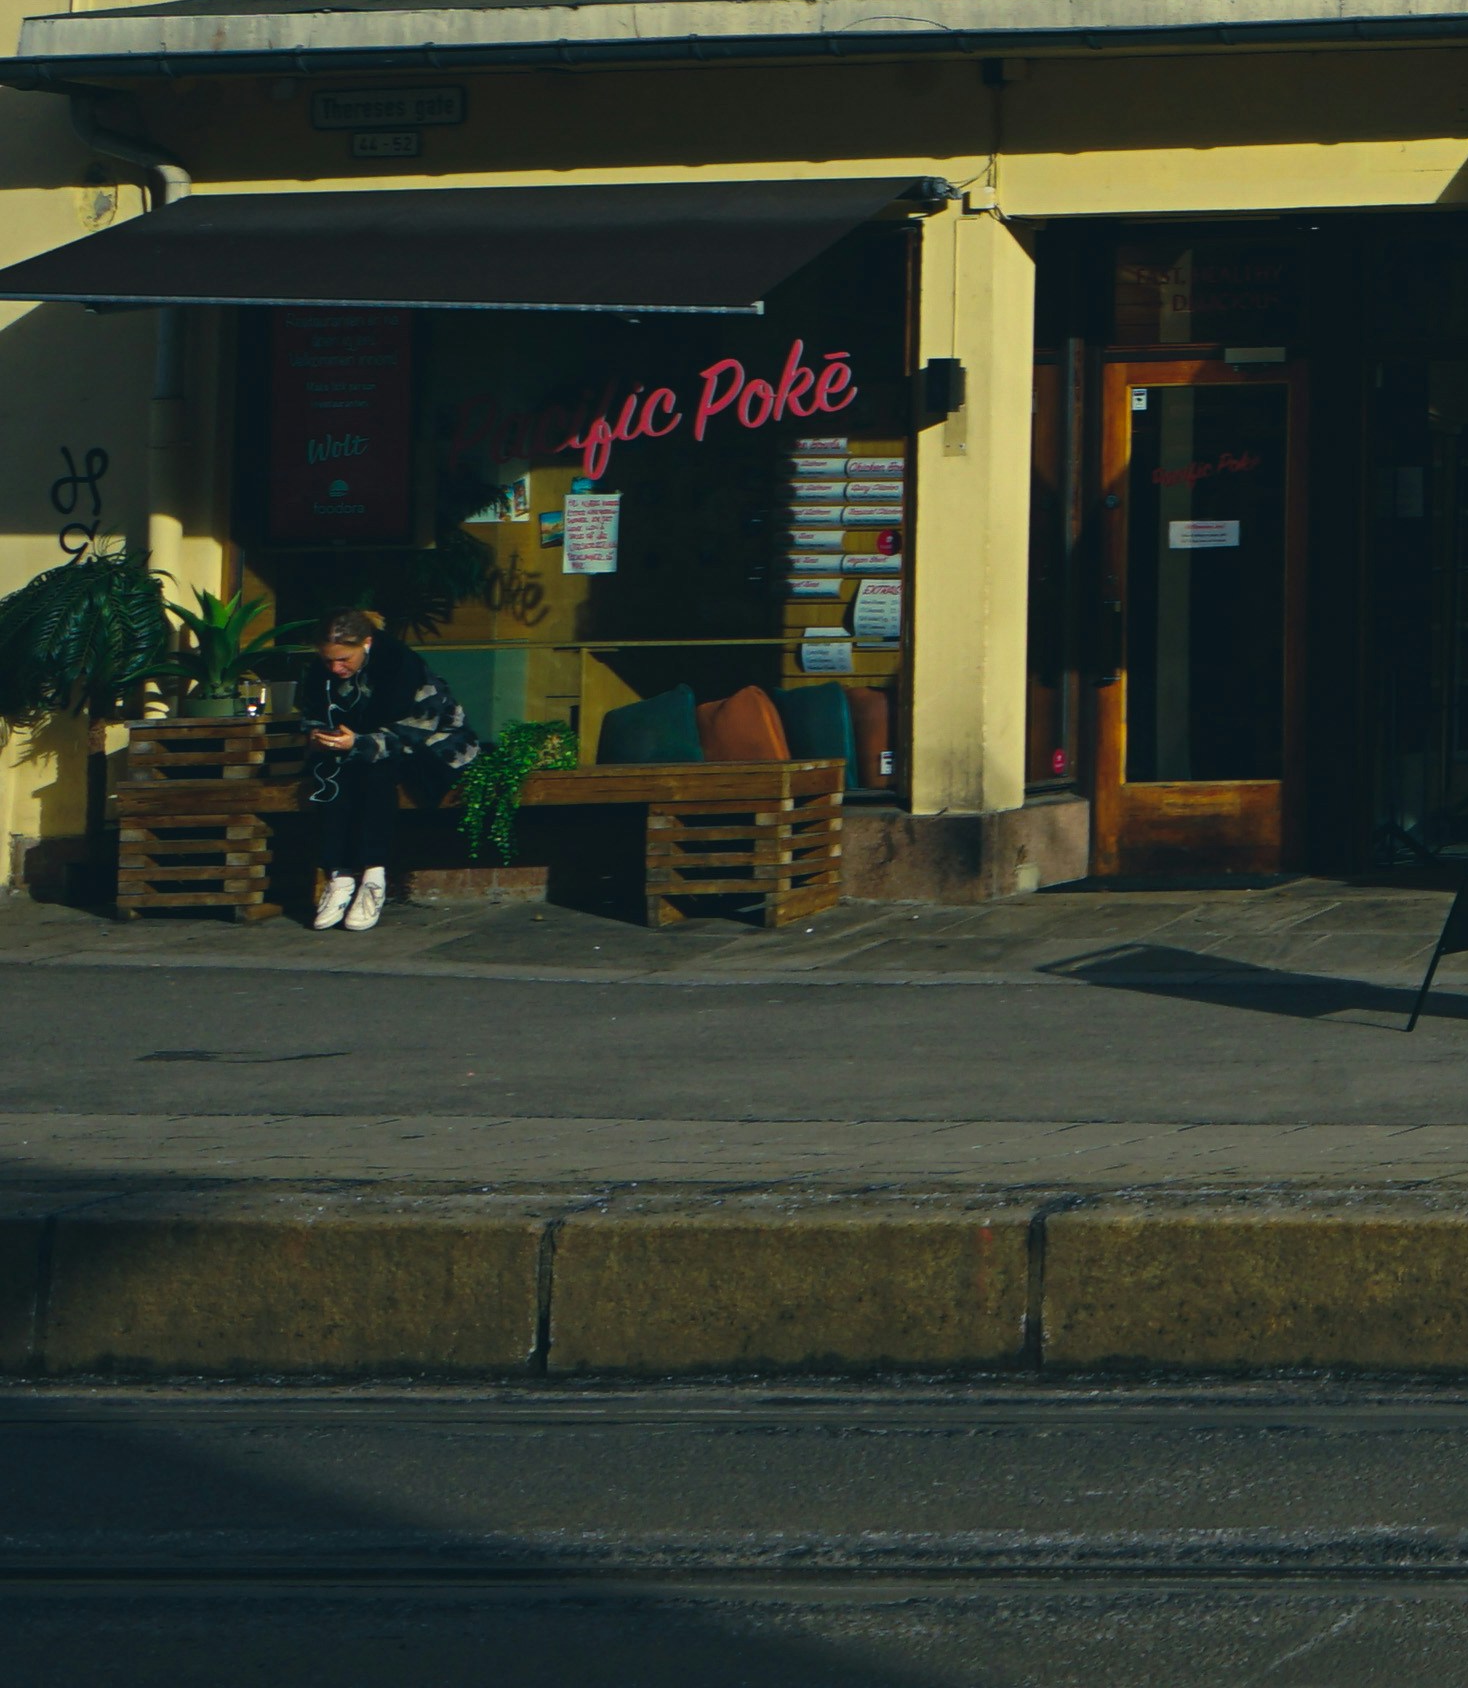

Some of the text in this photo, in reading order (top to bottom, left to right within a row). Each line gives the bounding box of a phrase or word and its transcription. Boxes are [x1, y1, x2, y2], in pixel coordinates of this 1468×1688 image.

[450, 376, 683, 481] Pacific
[307, 433, 370, 465] Wolt
[313, 501, 366, 514] foodora
